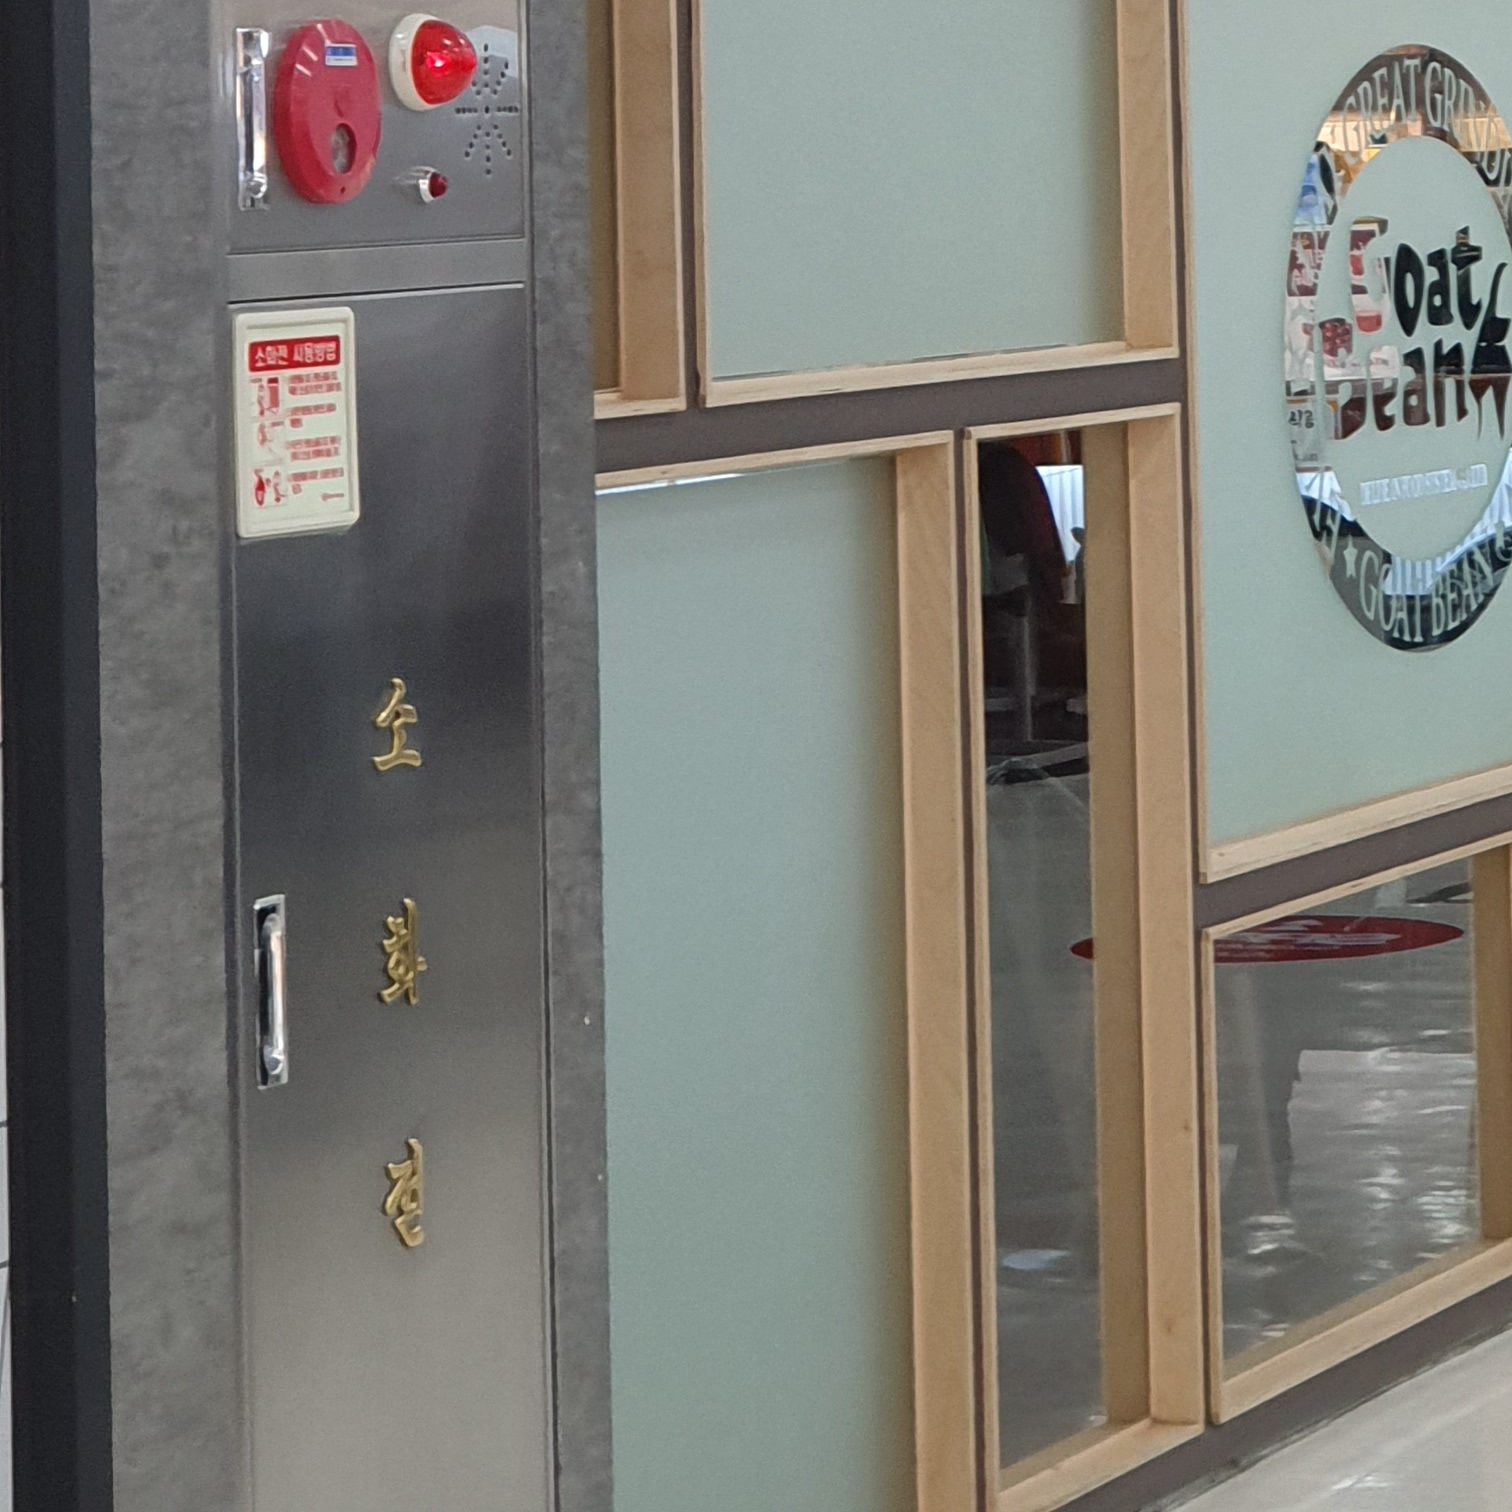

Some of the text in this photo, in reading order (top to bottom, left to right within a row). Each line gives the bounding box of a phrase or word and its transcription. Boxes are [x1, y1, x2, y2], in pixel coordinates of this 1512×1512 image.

[1350, 215, 1483, 338] Goat
[1320, 317, 1470, 441] Bean
[1359, 544, 1495, 643] GOAT BEAN
